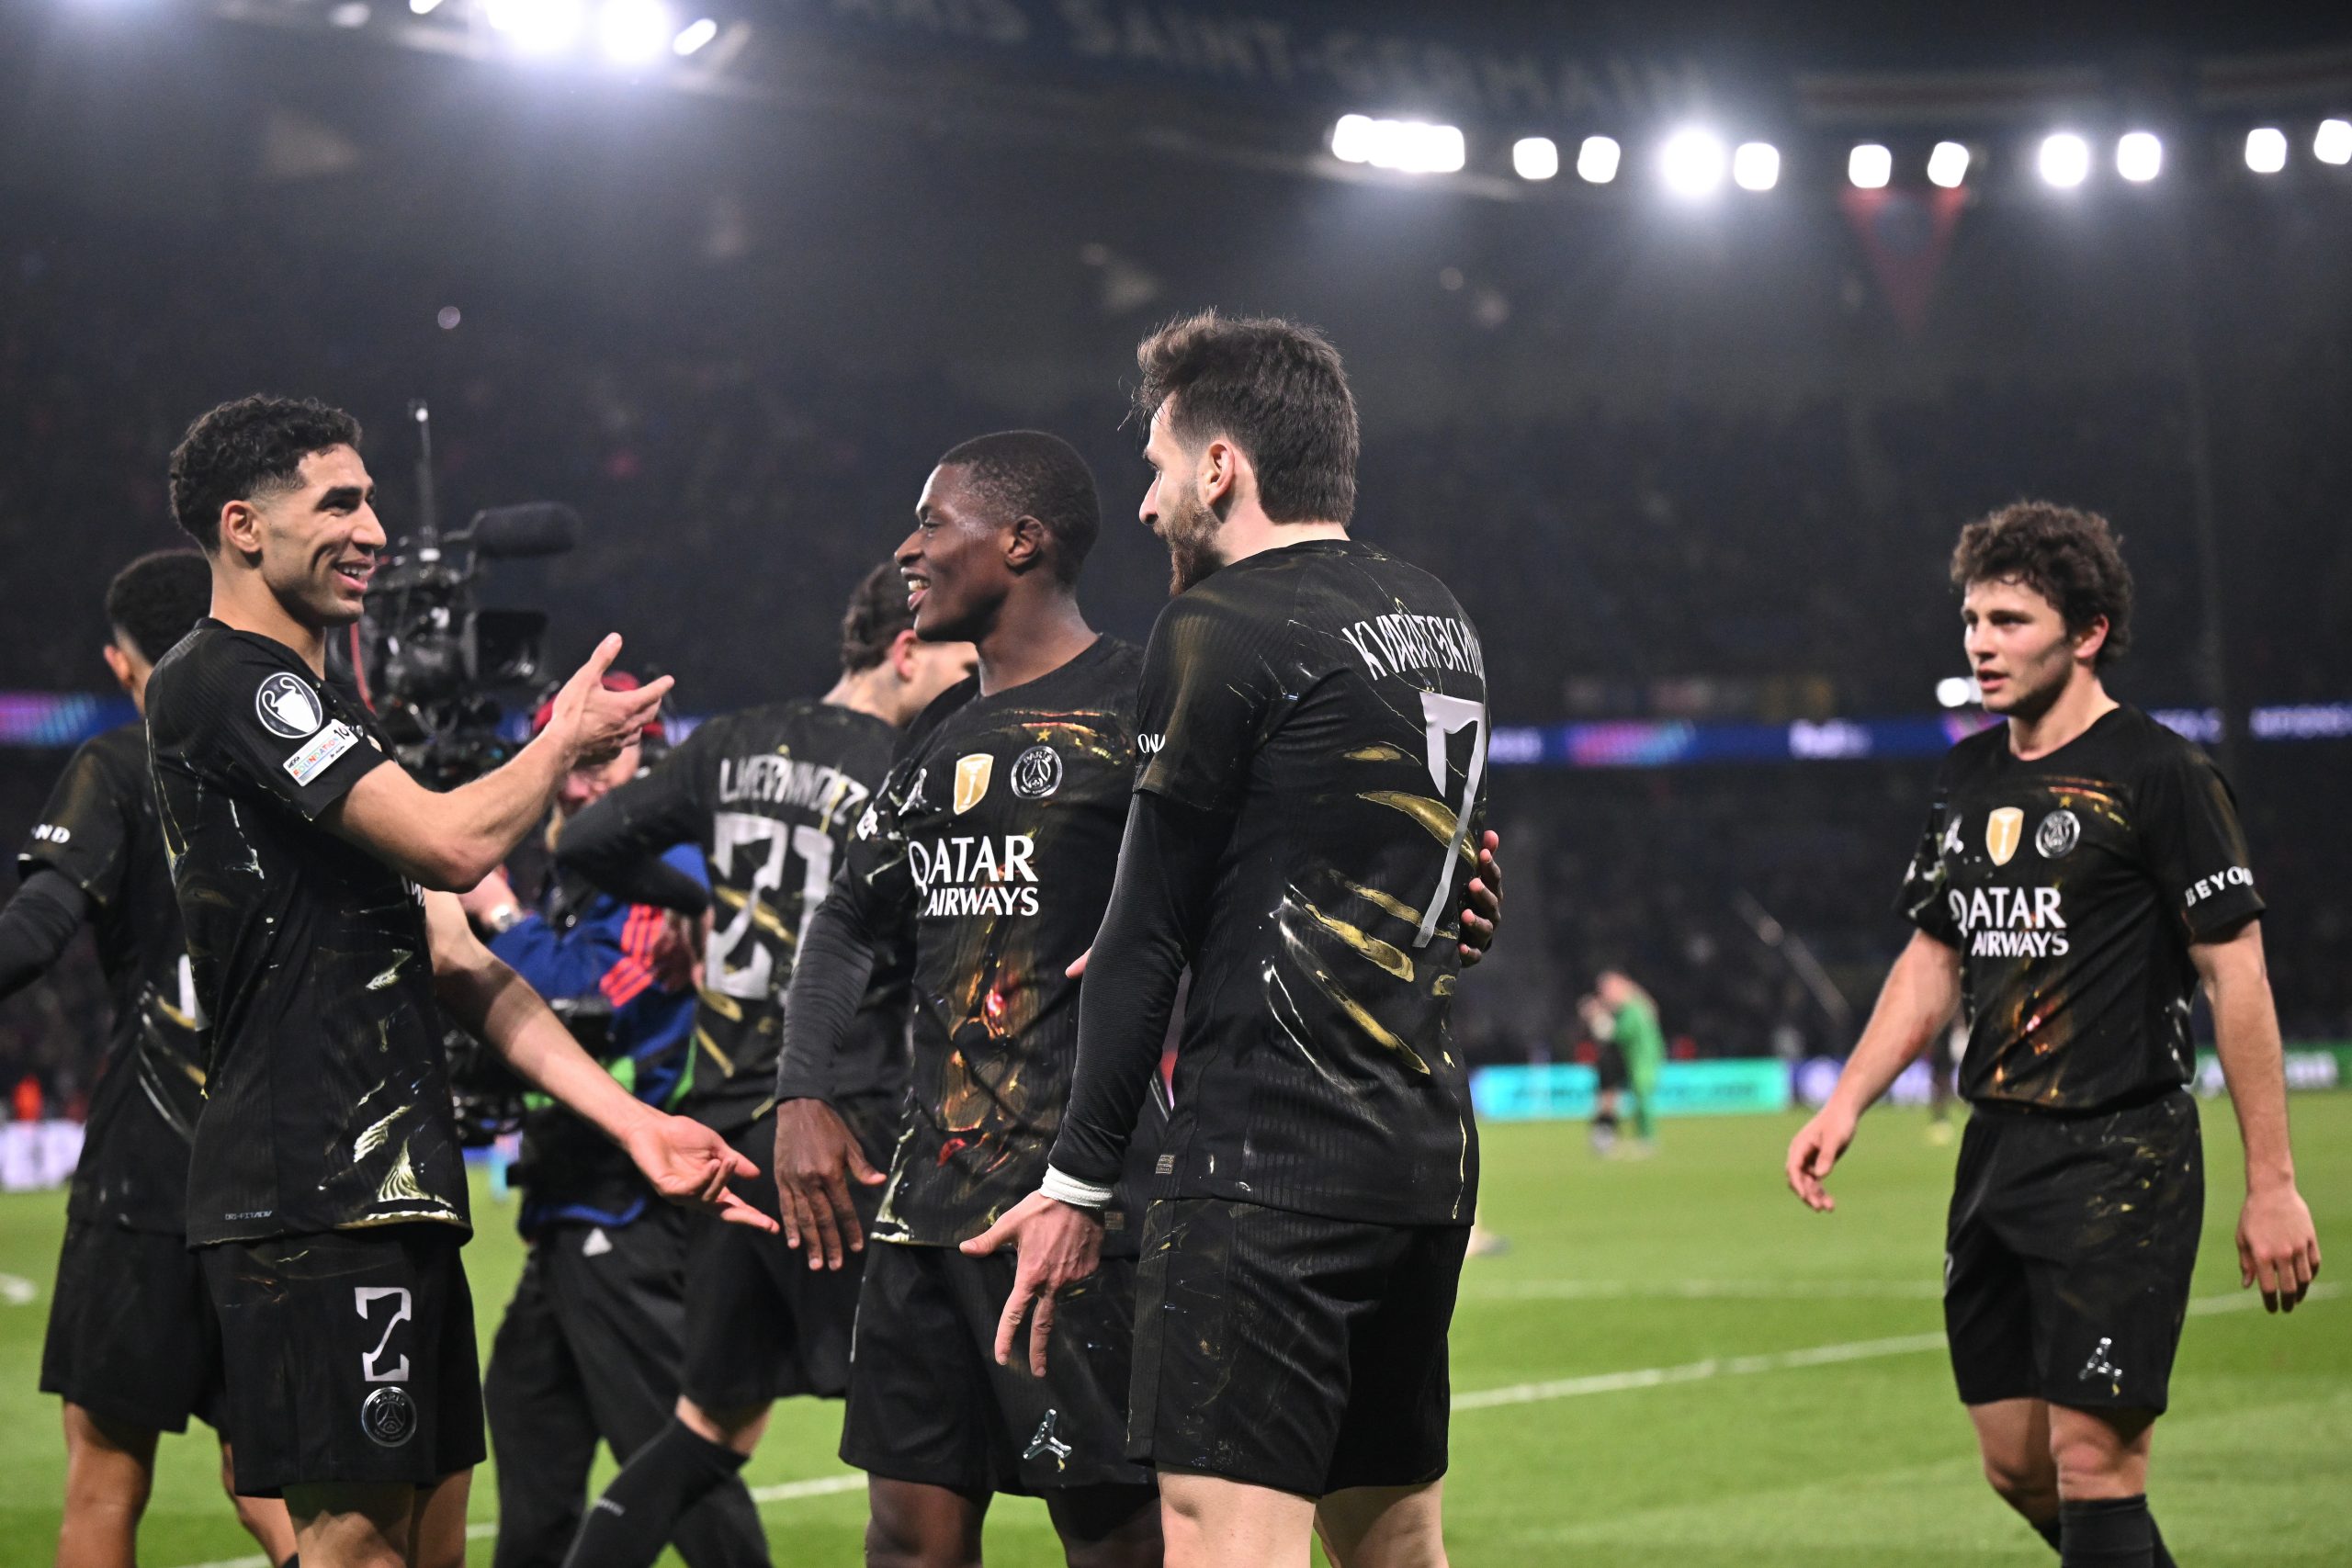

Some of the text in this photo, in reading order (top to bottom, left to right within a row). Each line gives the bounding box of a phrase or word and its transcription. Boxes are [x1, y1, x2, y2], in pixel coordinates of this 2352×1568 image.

[293, 737, 339, 777] FOUNDATION
[1413, 692, 1486, 948] 7
[908, 835, 1039, 897] QATAR
[925, 886, 1039, 917] AIRWAYS
[1948, 886, 2067, 939] QATAR
[1971, 931, 2070, 958] AIRWAYS
[354, 1286, 412, 1382] 2
